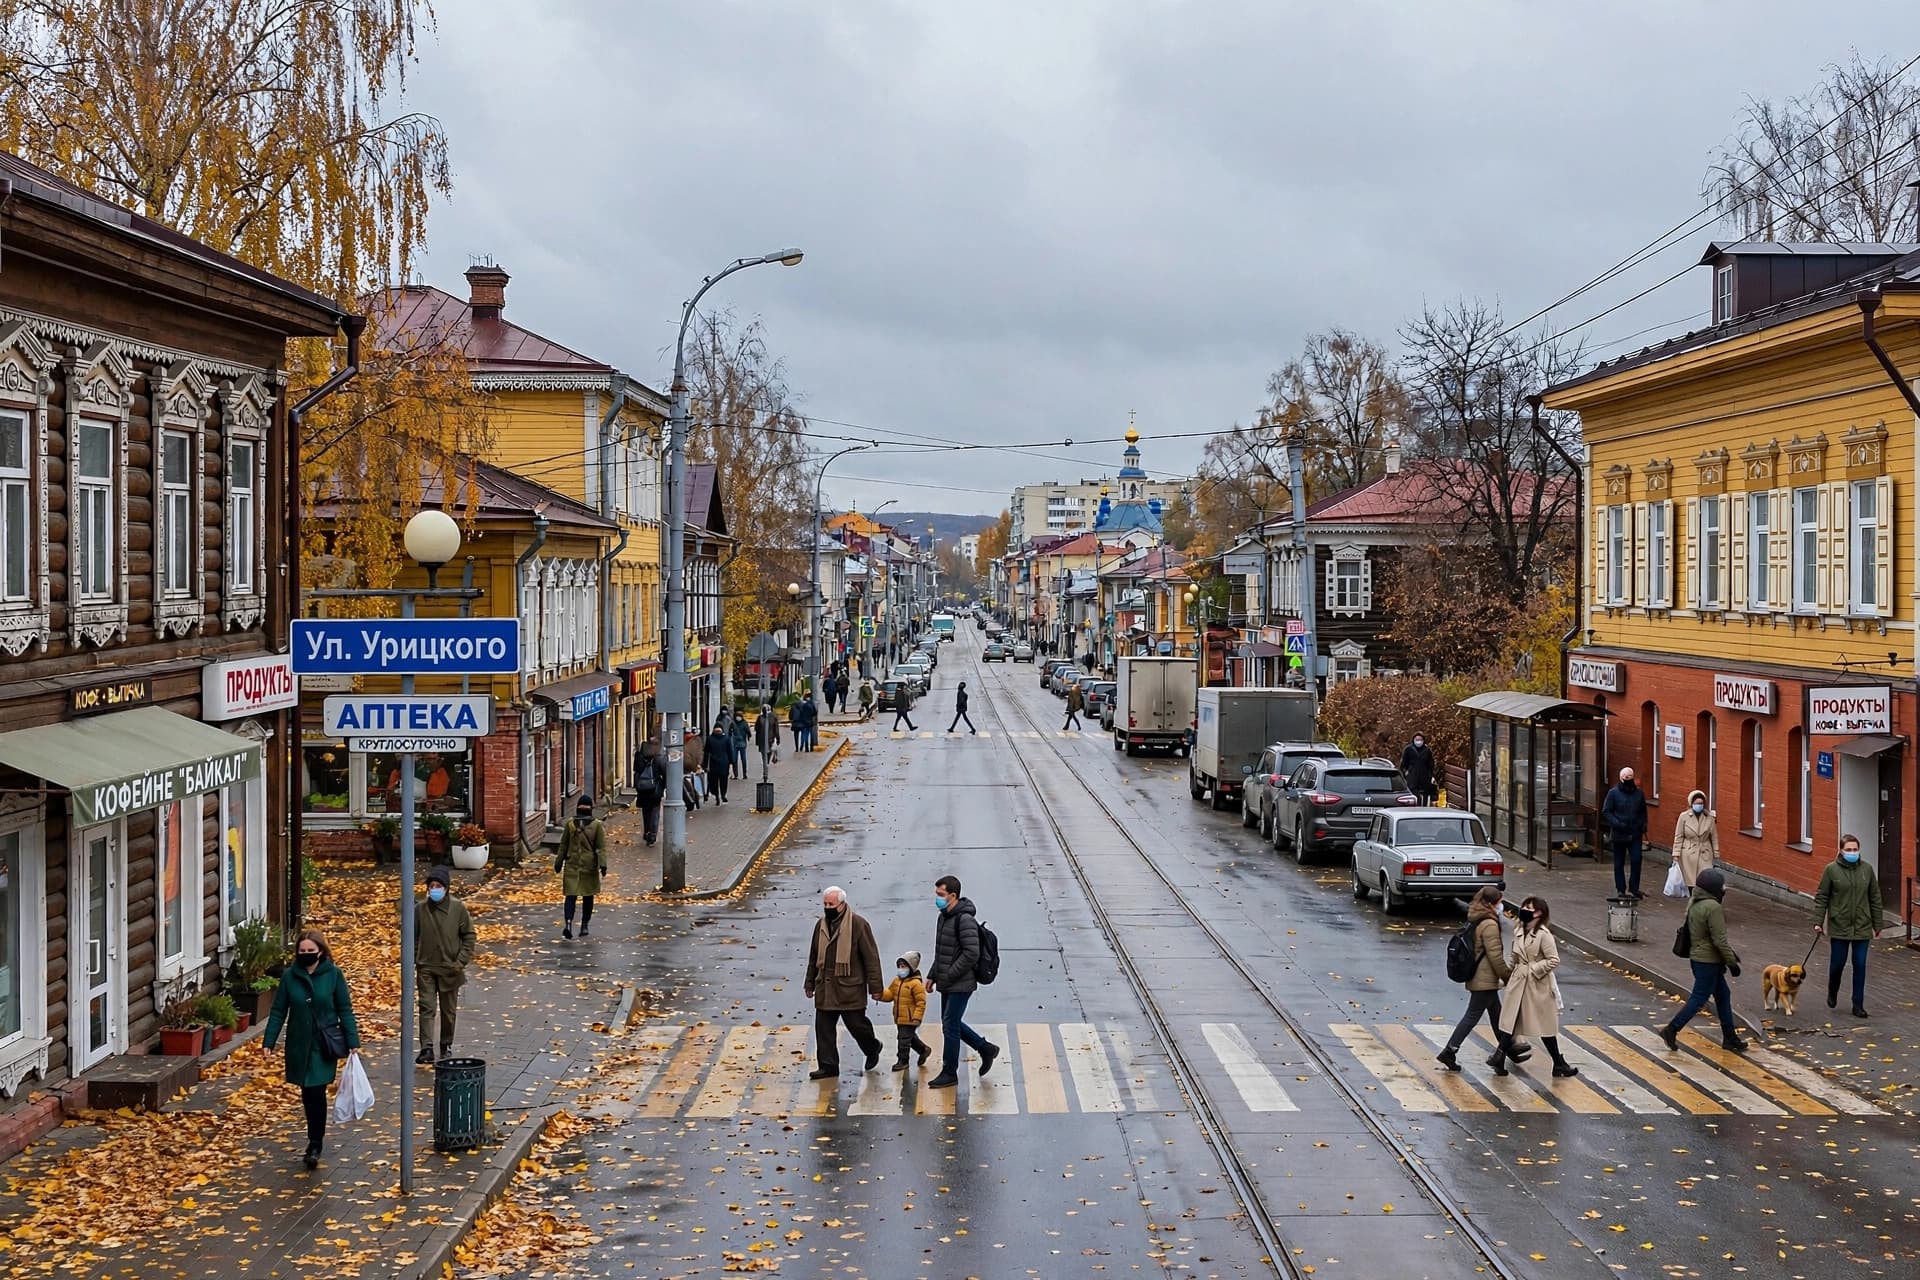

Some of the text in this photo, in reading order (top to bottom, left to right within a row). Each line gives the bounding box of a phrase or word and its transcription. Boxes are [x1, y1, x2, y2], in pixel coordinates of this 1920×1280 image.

[305, 630, 507, 667] Ул. Урицкого
[227, 665, 293, 704] ПРОДУКТЫ
[1716, 680, 1768, 708] ПРОДУКТЫ
[336, 703, 479, 730] АПТЕКА
[1813, 698, 1886, 715] ПРОДУКТЫ
[94, 768, 174, 821] КОФЕЙНЕ
[178, 751, 248, 795] "БАЙКАЛ"
